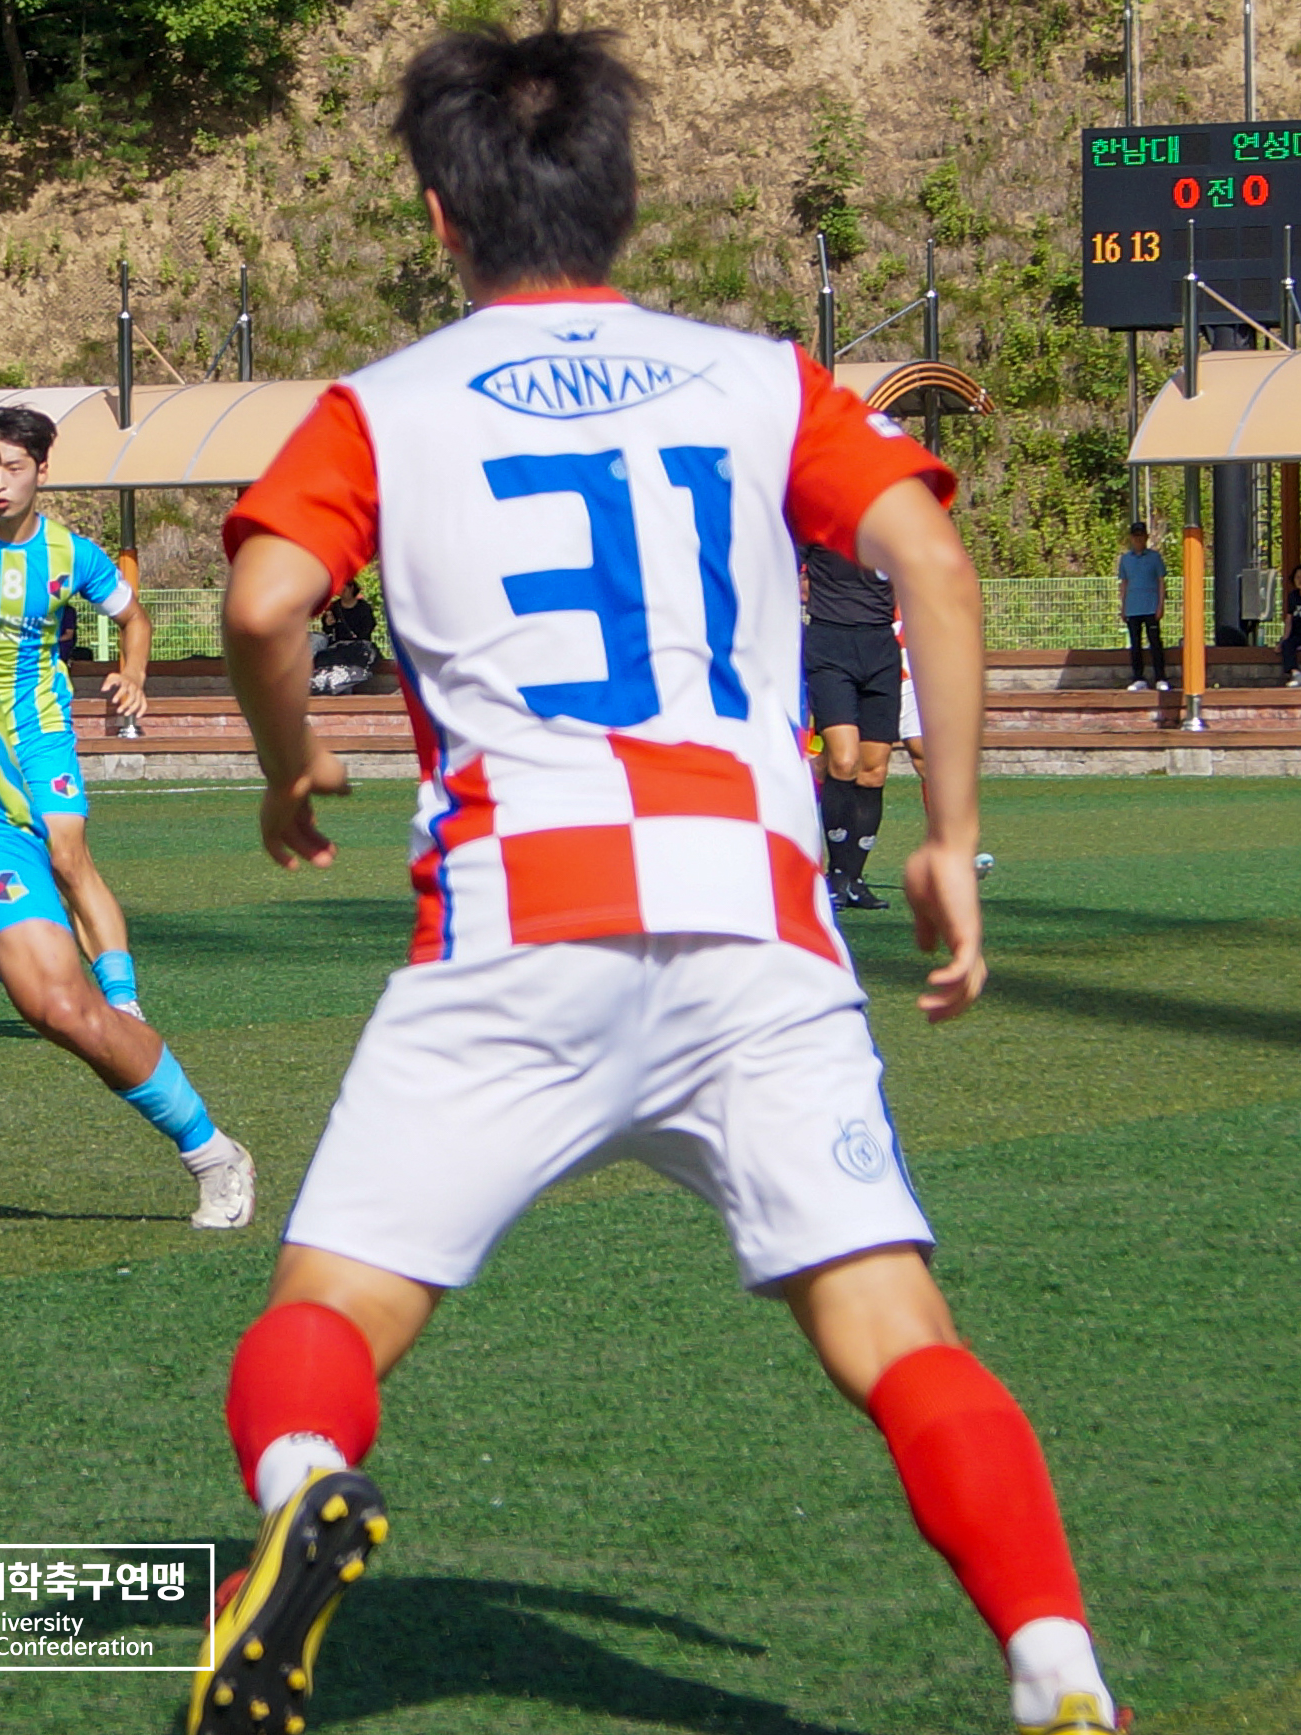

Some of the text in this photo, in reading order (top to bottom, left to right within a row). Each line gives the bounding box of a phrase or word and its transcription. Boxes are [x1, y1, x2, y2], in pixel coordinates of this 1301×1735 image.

[1091, 135, 1180, 167] 한남대
[1173, 174, 1269, 209] 0 전 0
[1091, 231, 1161, 263] 16 13
[495, 357, 673, 409] HANNAM
[3, 568, 23, 600] 8
[482, 446, 749, 727] 31
